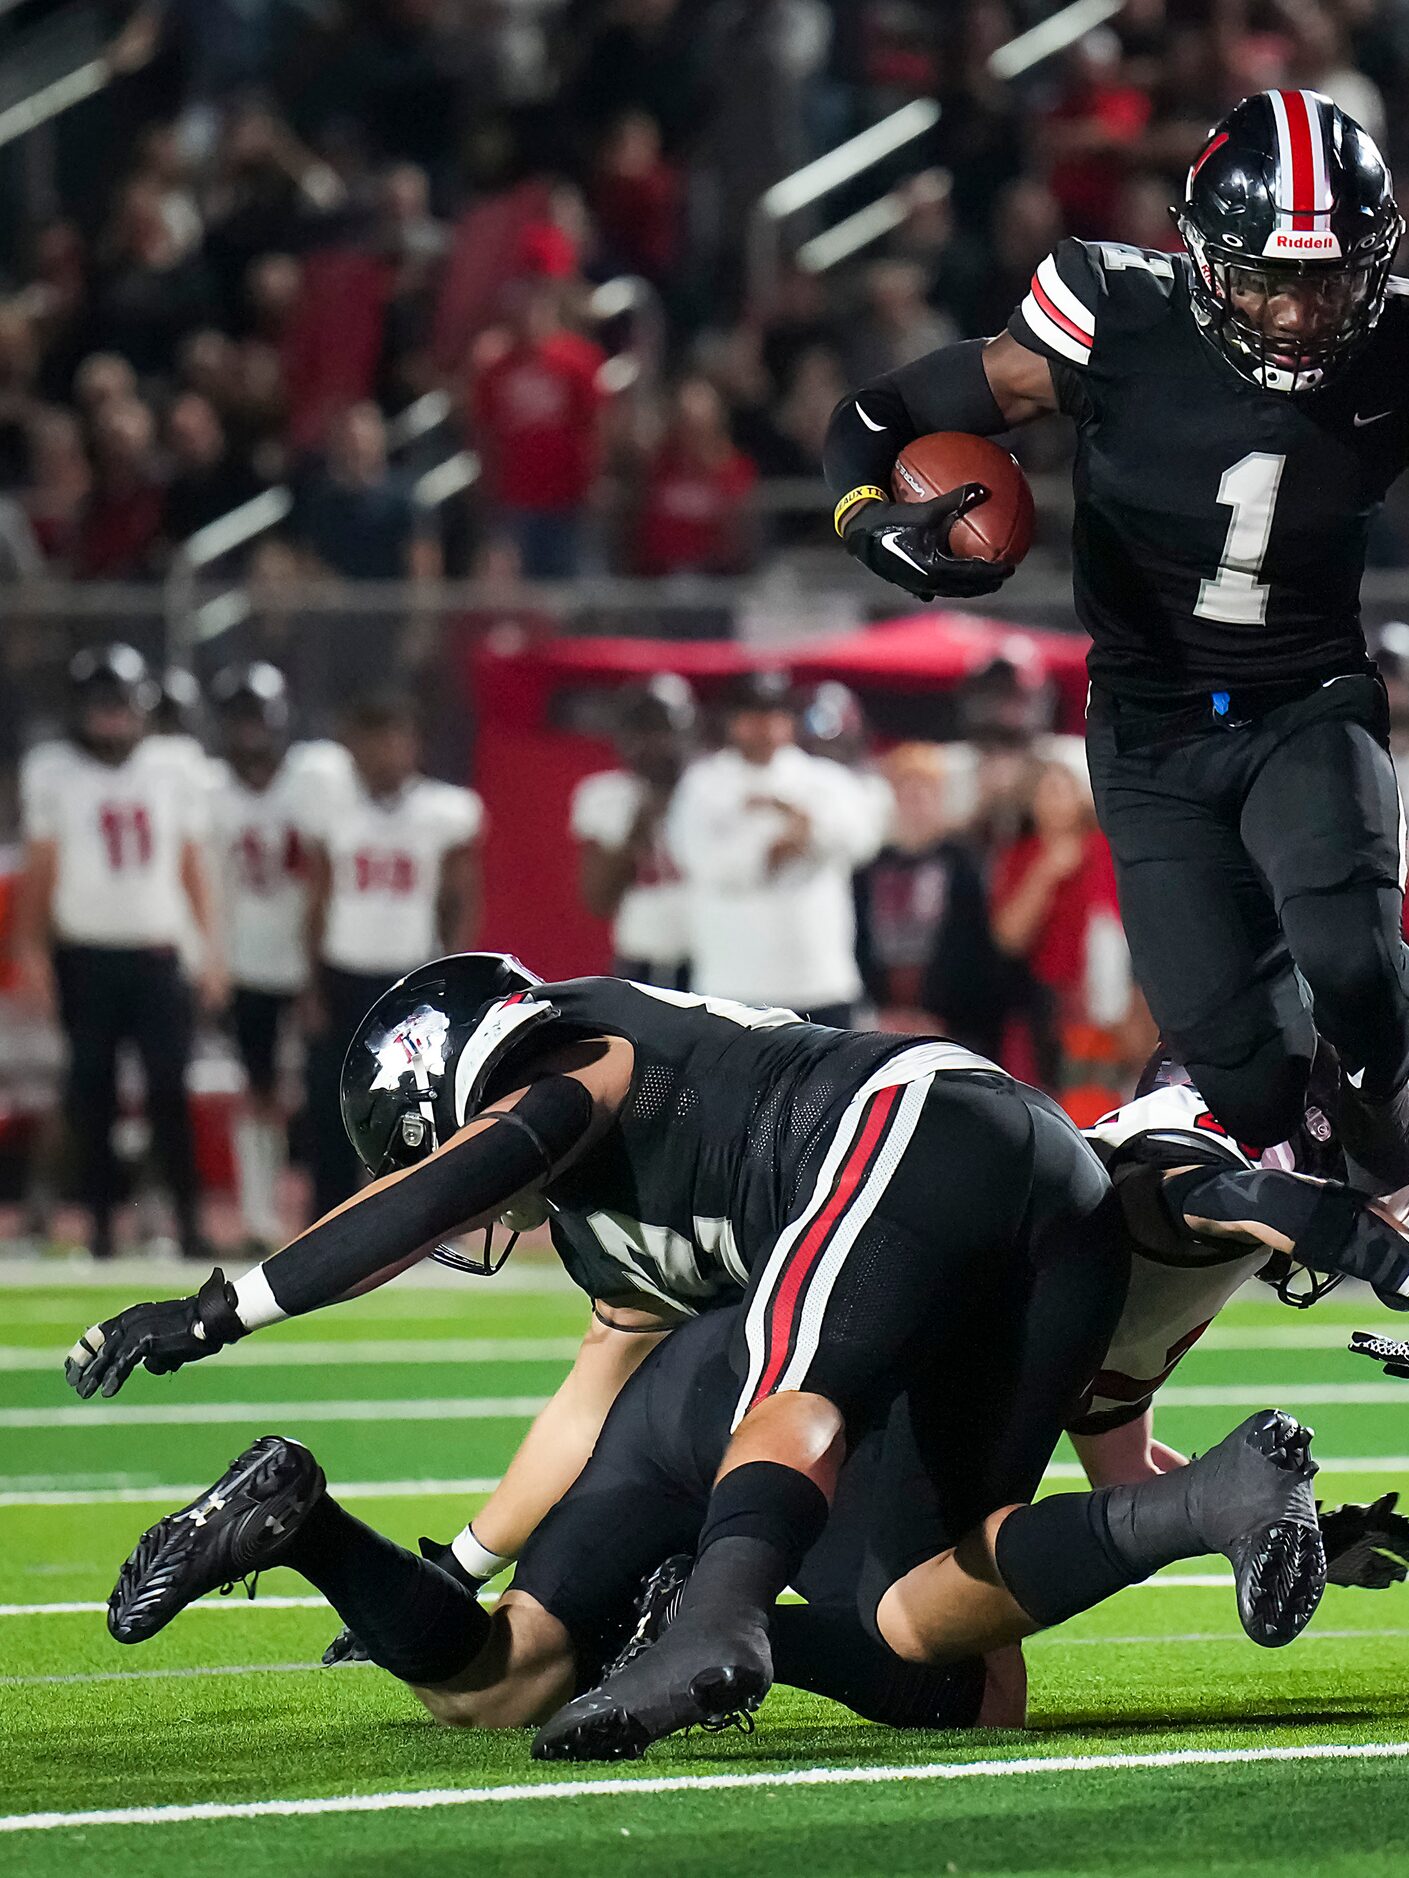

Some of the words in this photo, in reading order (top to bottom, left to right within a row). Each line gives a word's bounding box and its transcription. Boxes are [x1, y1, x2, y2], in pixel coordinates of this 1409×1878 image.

[1276, 235, 1333, 249] Riddell
[1193, 451, 1287, 627] 1
[100, 803, 153, 871] 11
